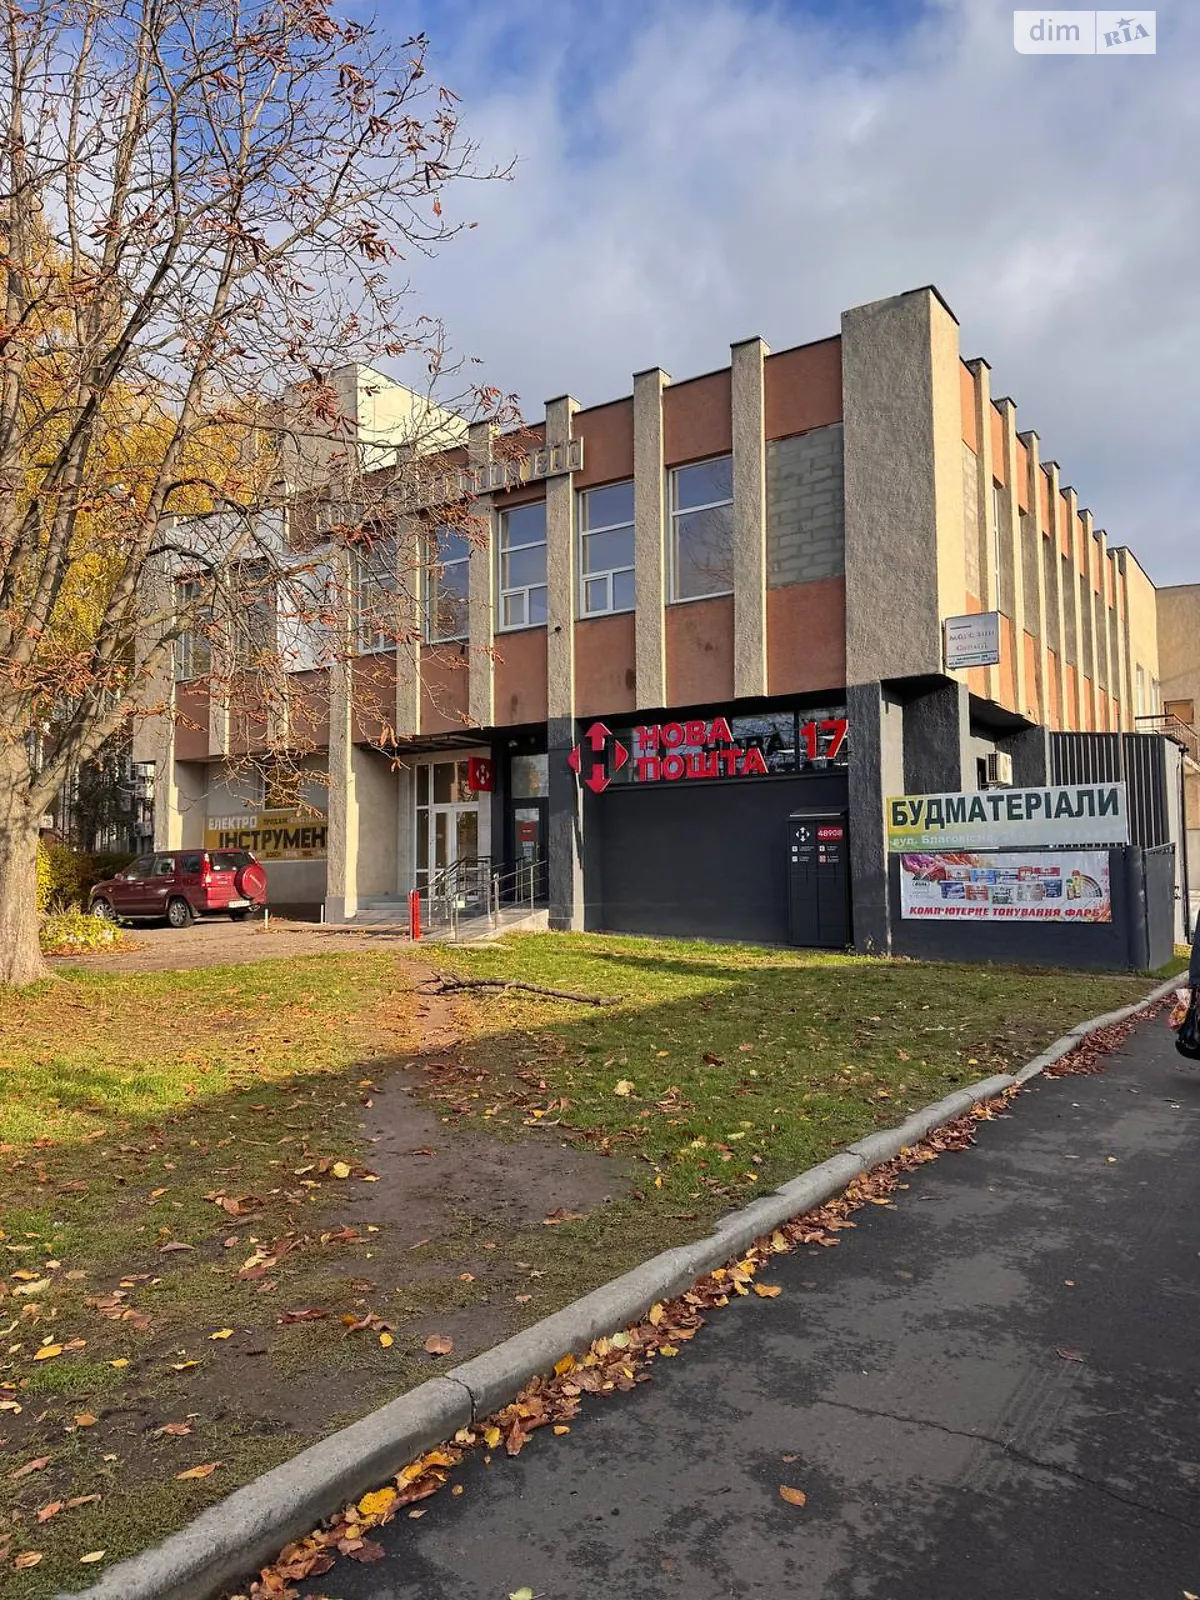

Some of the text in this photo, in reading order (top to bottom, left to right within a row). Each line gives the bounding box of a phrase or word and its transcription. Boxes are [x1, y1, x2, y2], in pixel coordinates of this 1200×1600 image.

[637, 717, 734, 750] НОВА
[800, 719, 849, 761] 17
[637, 748, 768, 781] ПОШТА
[208, 816, 257, 830] ЕЛЕКТРО
[892, 788, 1119, 829] БУДМАТЕРІАЛИ
[891, 836, 918, 846] вул.
[992, 906, 1060, 917] ТОНУВАННЯ
[1064, 908, 1100, 918] ФАРБ
